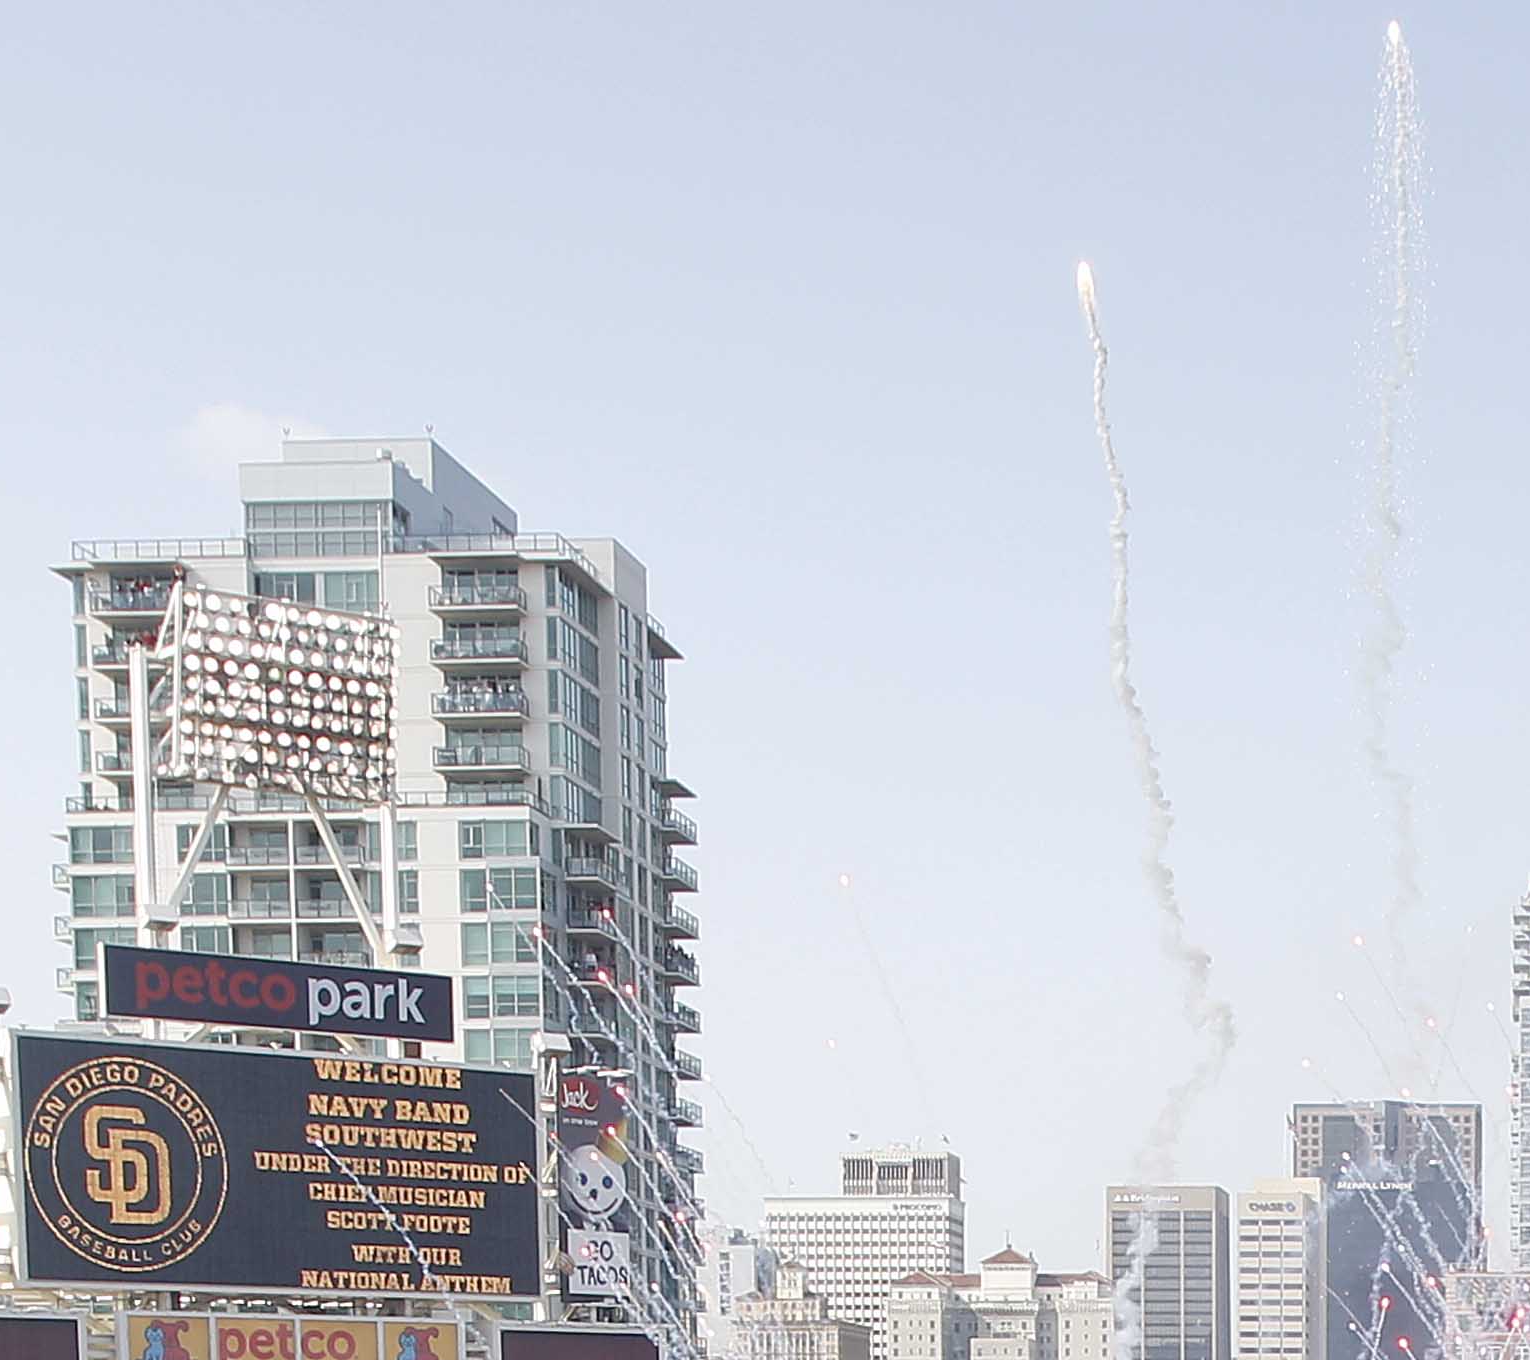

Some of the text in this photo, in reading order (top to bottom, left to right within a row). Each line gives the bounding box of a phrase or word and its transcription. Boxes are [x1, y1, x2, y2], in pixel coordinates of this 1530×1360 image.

[134, 959, 426, 1026] petco park
[314, 1059, 462, 1089] WELCOME
[34, 1064, 218, 1157] SAN DIEGO PADRES
[308, 1095, 470, 1125] NAVY BAND
[304, 1125, 477, 1153] SOUTHWEST
[254, 1151, 331, 1175] UNDER
[338, 1154, 381, 1177] THE
[387, 1161, 499, 1184] DIRECTION
[308, 1183, 486, 1209] CHIEF MUSICIAN
[327, 1211, 470, 1234] SCOTT FOOTE
[57, 1213, 202, 1262] BASEBALL CLUB
[351, 1245, 463, 1267] WITH OUR
[301, 1270, 511, 1294] NATIONAL ANTHEM
[577, 1265, 629, 1287] TACOS
